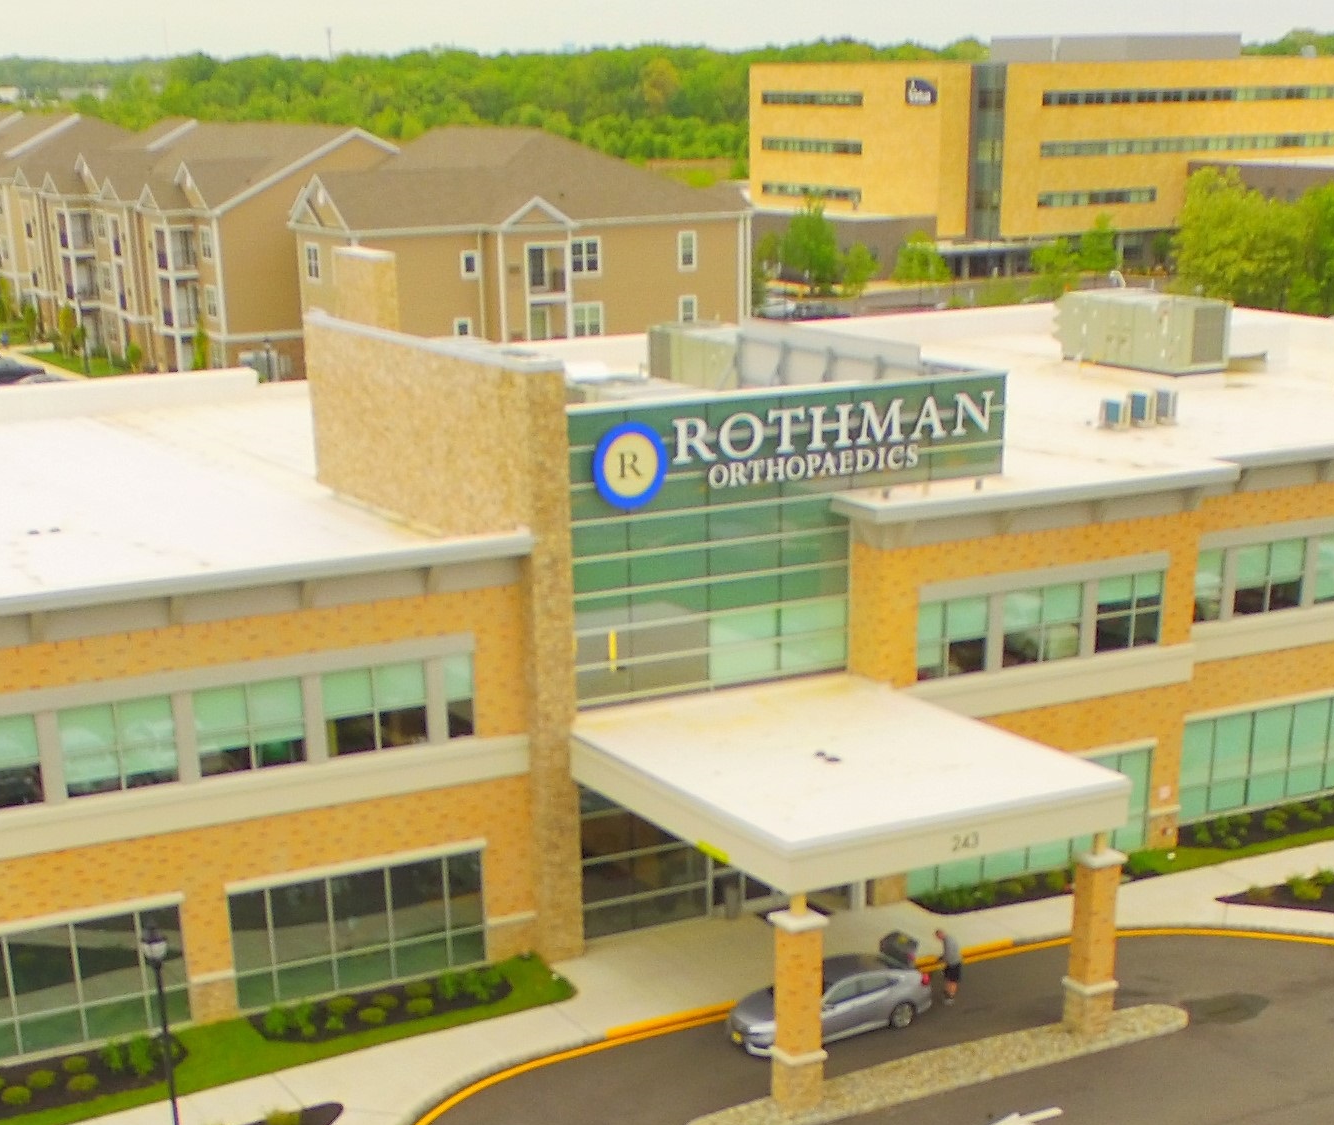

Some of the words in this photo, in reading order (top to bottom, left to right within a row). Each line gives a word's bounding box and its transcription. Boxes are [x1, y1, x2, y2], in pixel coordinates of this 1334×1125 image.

[671, 390, 995, 465] ROTHMAN
[618, 452, 642, 479] R
[708, 445, 918, 489] ORTHOPAEDICS
[952, 831, 979, 851] 243
